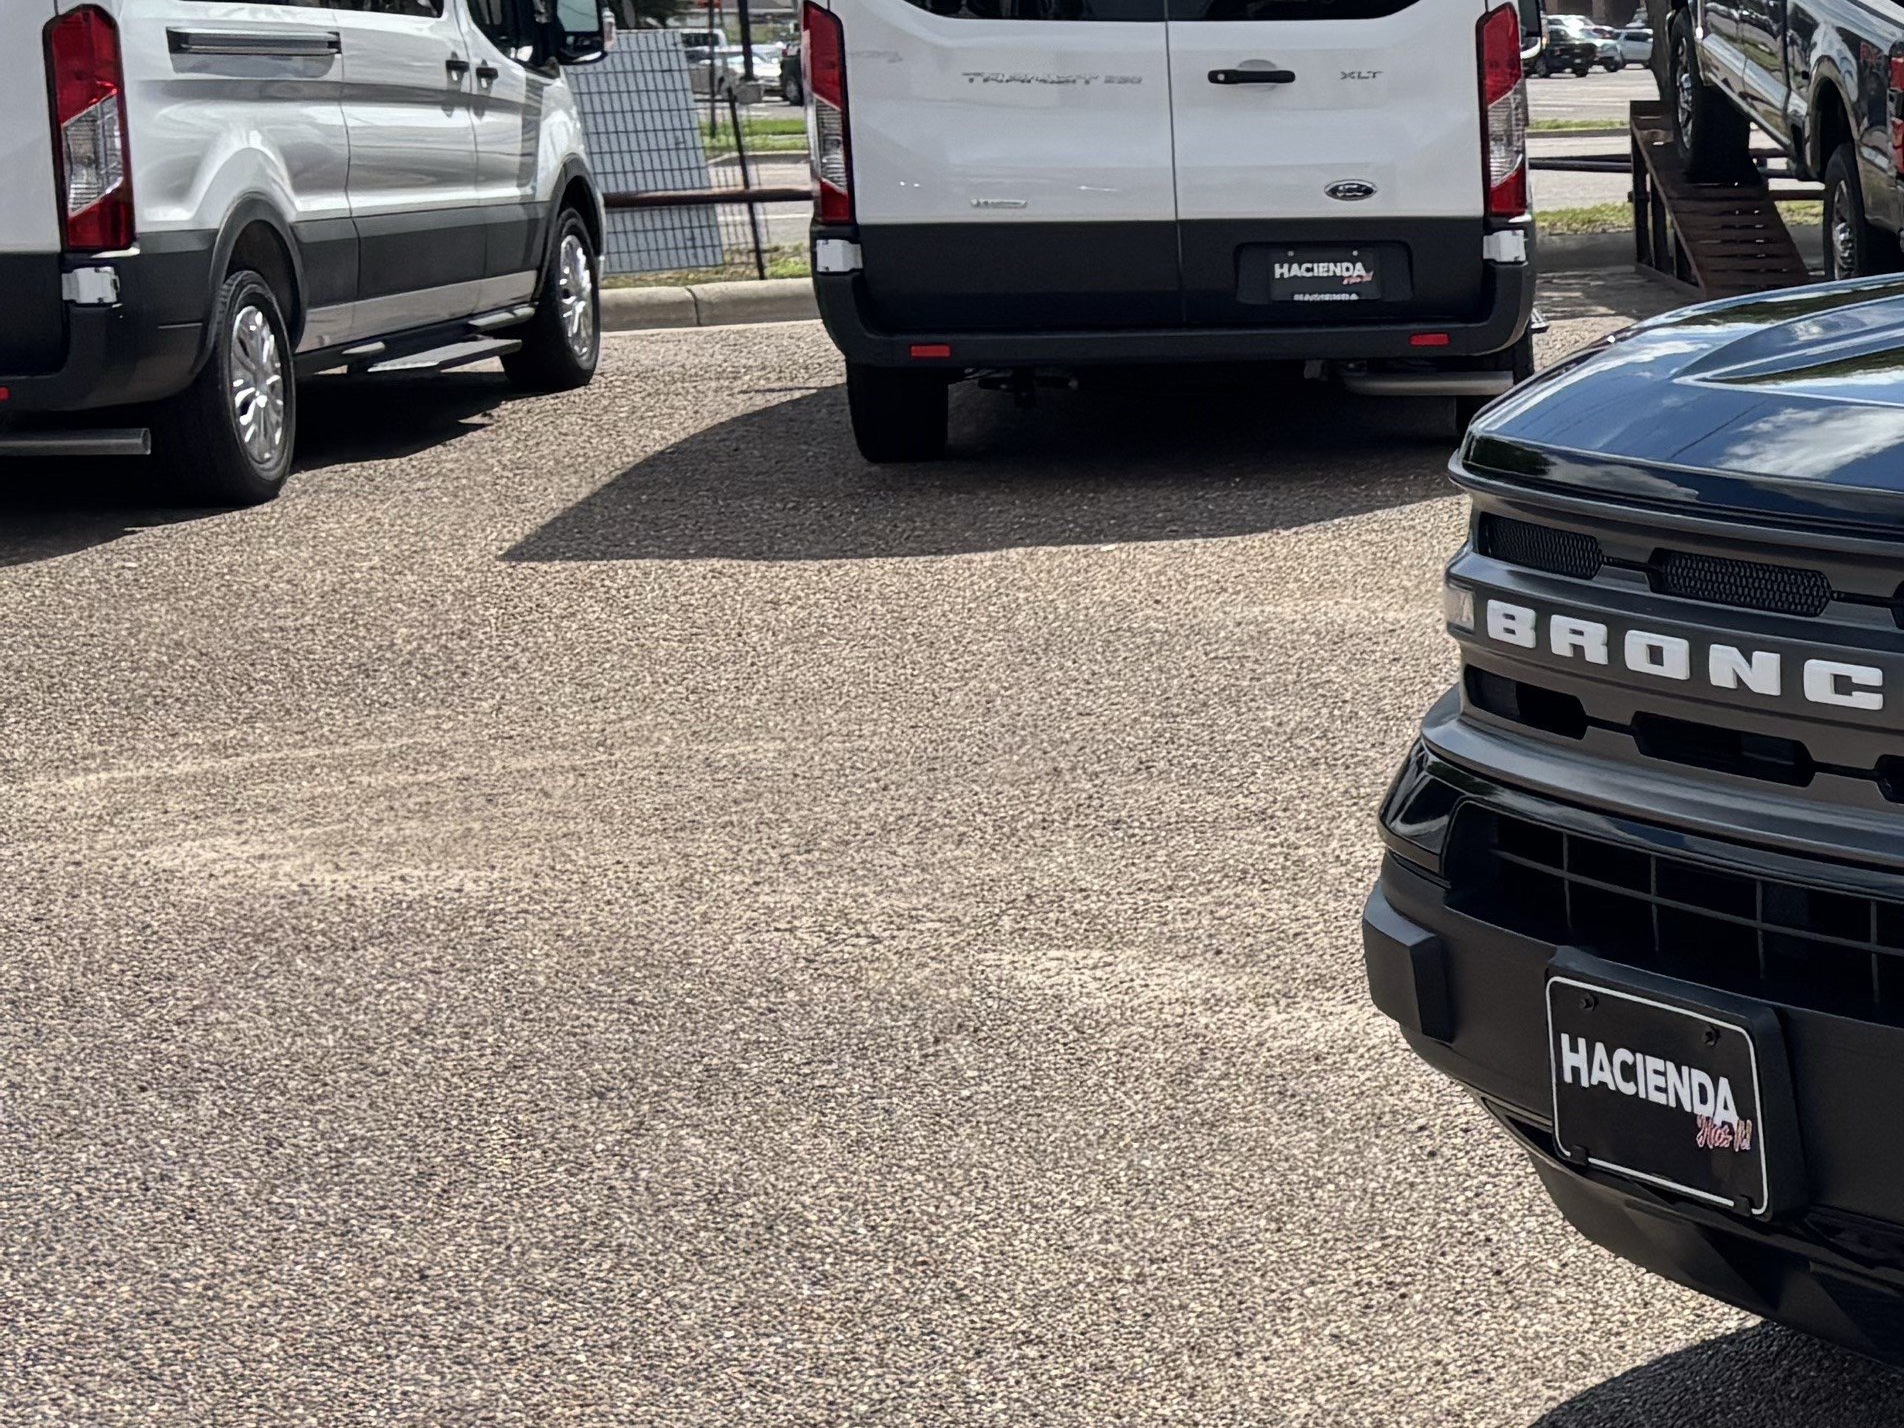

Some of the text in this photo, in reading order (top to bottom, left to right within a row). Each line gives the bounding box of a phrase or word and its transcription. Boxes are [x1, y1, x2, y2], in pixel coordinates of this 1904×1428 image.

[1340, 70, 1383, 80] XLT
[1273, 262, 1366, 279] HACIENDA
[1560, 1032, 1740, 1128] HACIENDA
